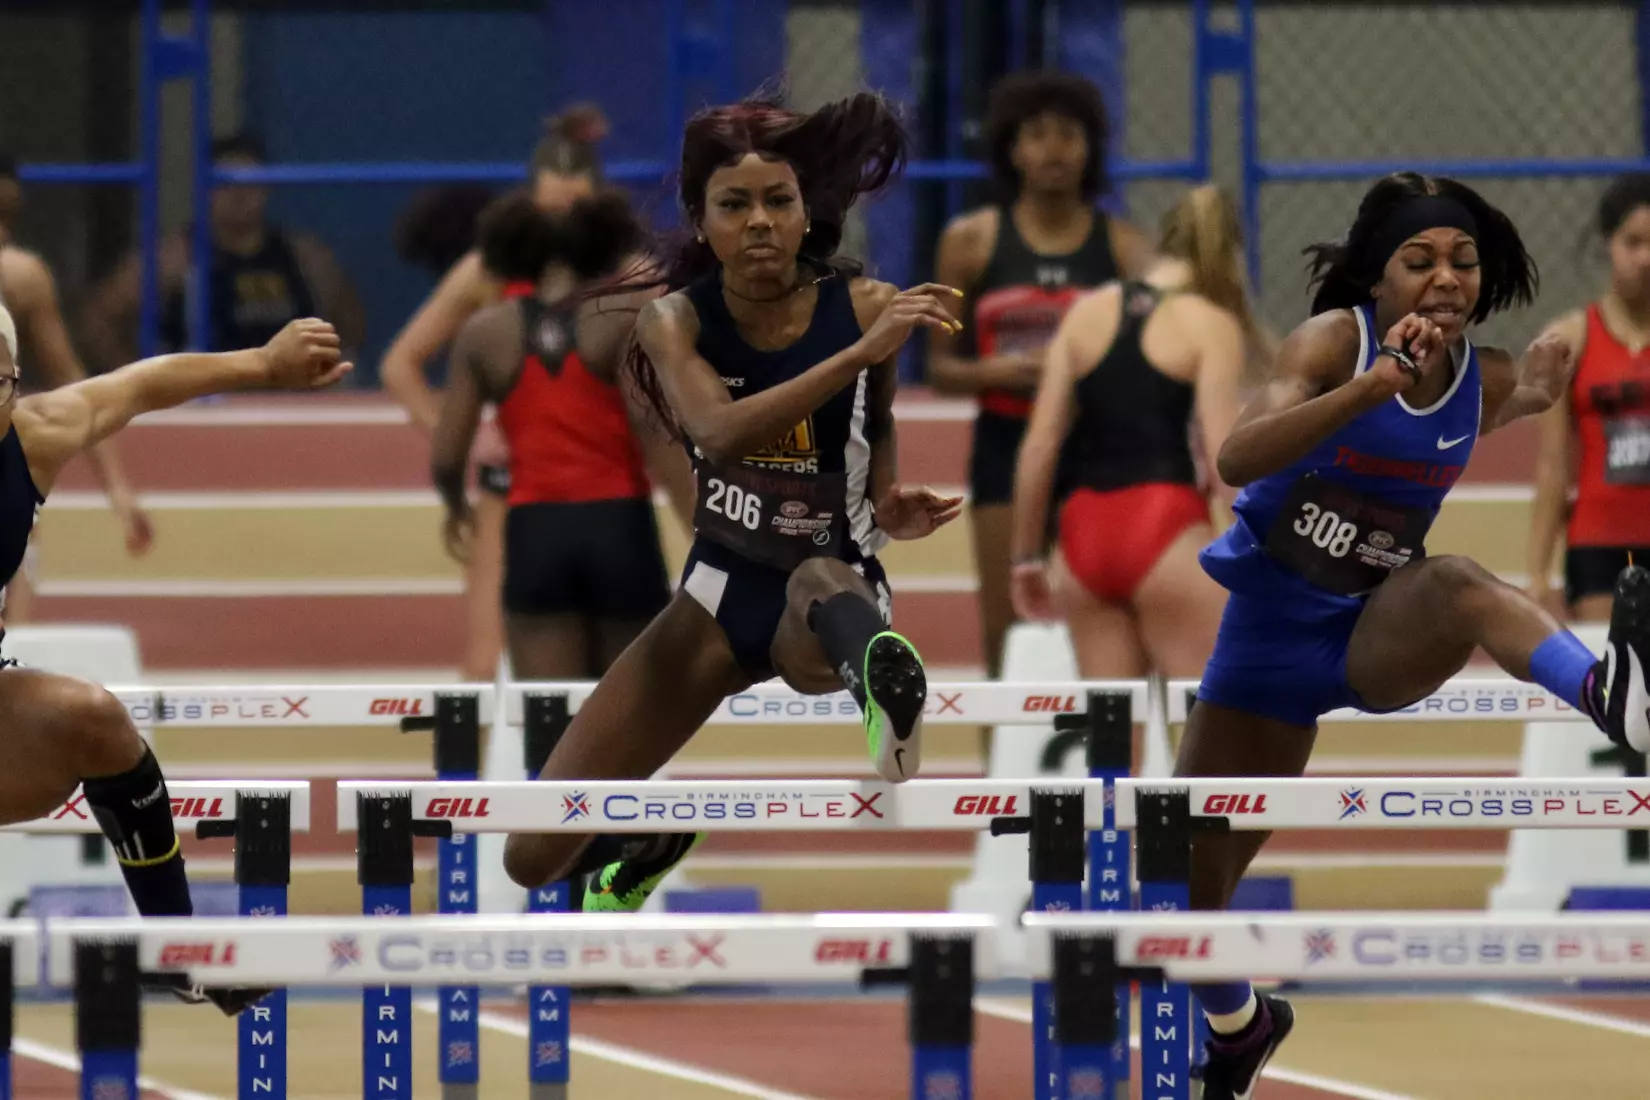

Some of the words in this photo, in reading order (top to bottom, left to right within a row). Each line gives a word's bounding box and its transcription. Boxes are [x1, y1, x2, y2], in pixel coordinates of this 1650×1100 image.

[706, 478, 762, 530] 206
[1293, 502, 1358, 558] 308
[368, 698, 423, 715] GILL
[1022, 695, 1076, 712] GILL
[686, 792, 803, 800] BIRMINGHAM
[1463, 789, 1581, 797] BIRMINGHAM
[425, 798, 490, 817] GILL
[953, 795, 1018, 815] GILL
[1202, 794, 1267, 814] GILL
